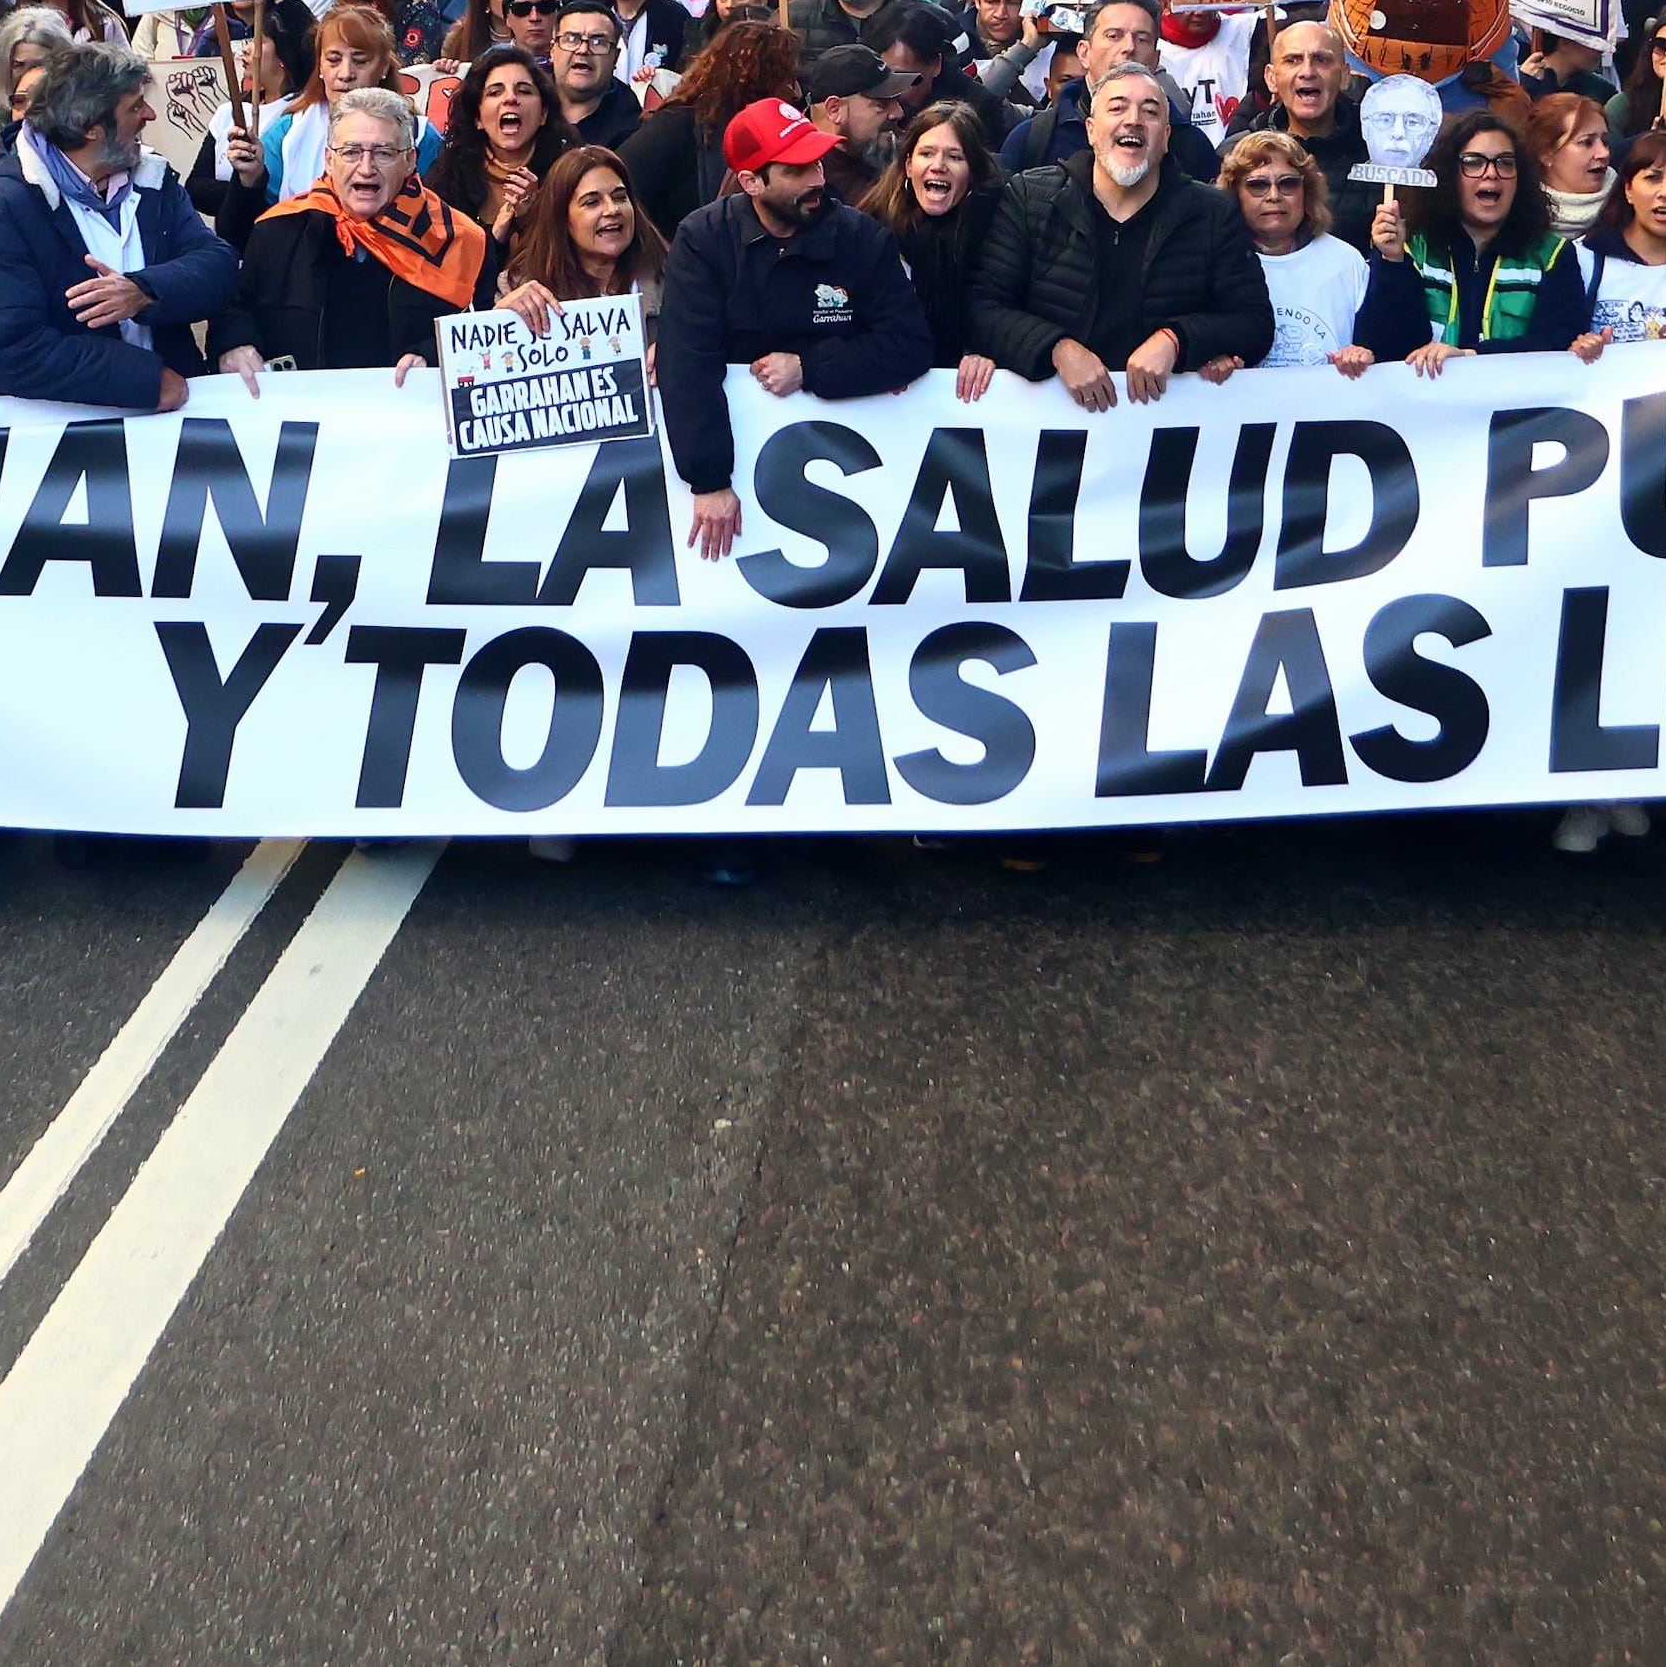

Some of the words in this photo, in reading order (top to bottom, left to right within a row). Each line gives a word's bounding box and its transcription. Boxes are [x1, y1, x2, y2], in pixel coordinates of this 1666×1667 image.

[1351, 164, 1438, 188] BUSCADO
[451, 321, 518, 355] NADIE
[560, 307, 632, 342] SALVA
[812, 314, 853, 324] Garrahan
[469, 370, 586, 419] GARRAHAN
[589, 366, 618, 398] ES
[458, 414, 533, 453] CAUSA
[532, 394, 639, 441] NACIONAL
[425, 428, 681, 607] LA
[735, 418, 1420, 611] SALUD
[154, 621, 307, 810] Y
[342, 620, 1038, 814] TODAS
[1095, 591, 1492, 800] LAS
